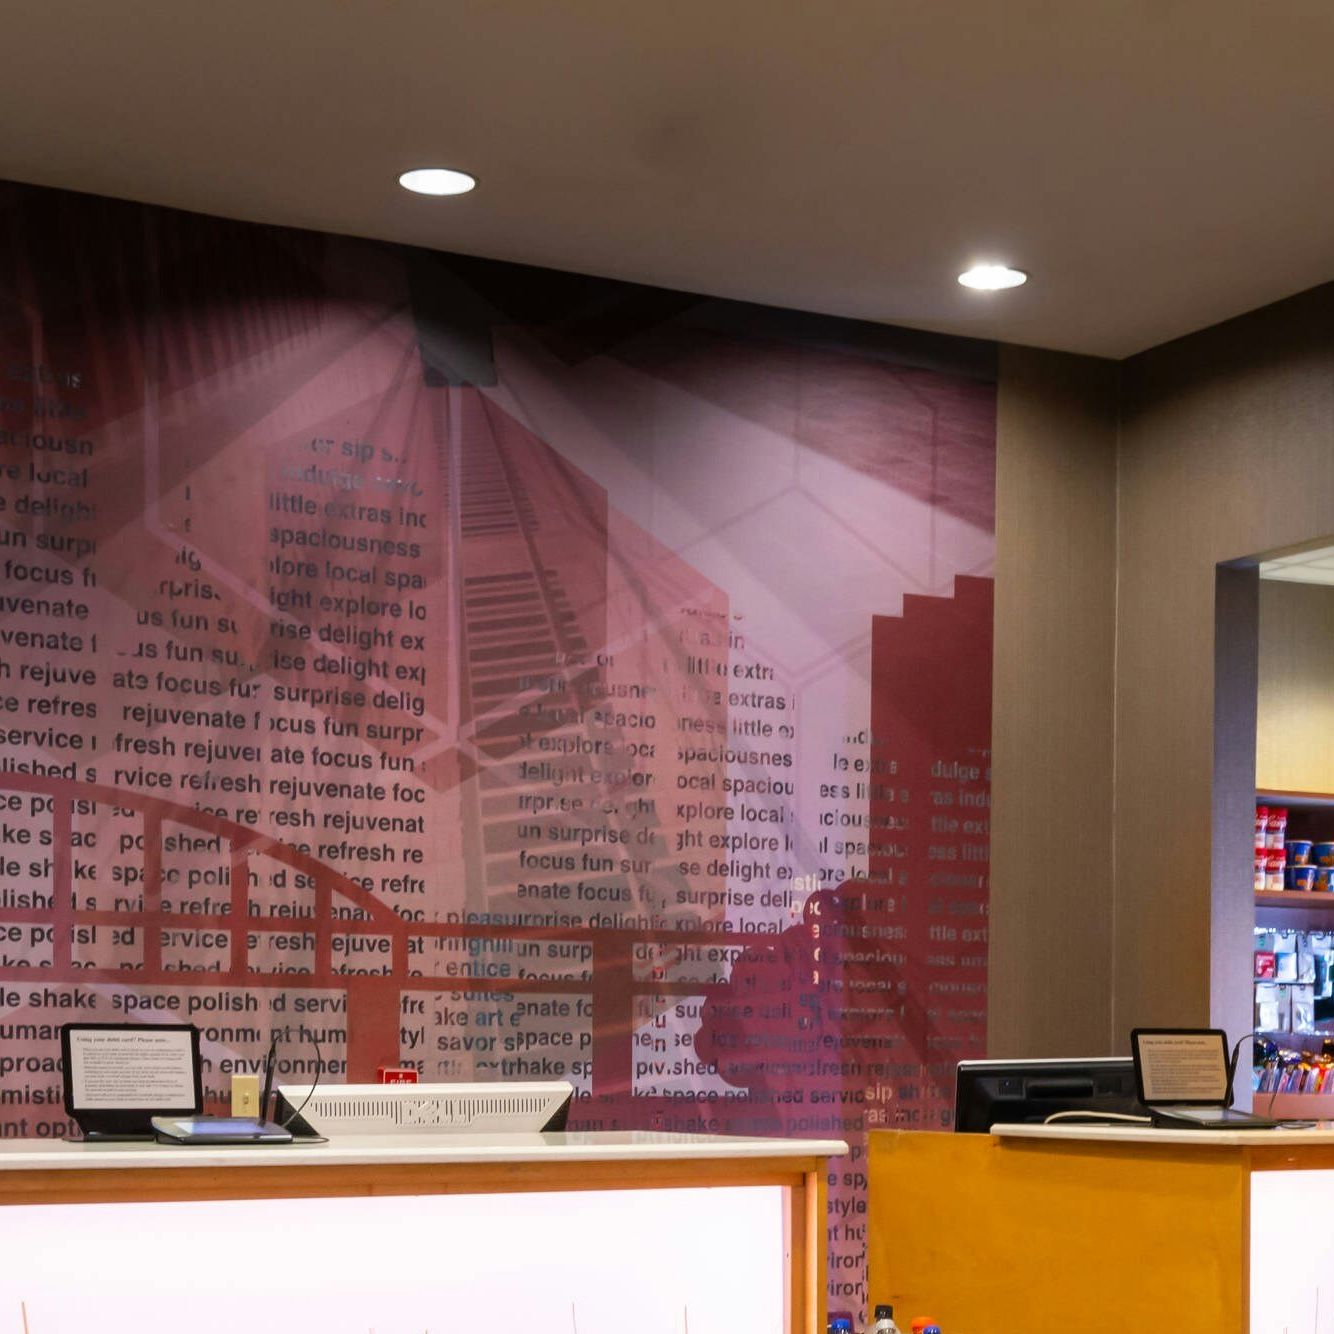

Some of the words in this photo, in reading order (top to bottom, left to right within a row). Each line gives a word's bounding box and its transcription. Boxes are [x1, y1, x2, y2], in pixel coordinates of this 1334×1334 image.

[324, 499, 392, 524] extras
[270, 527, 421, 558] spaciousness
[4, 560, 74, 587] focus
[325, 561, 377, 586] local
[319, 593, 402, 620] explore
[171, 610, 209, 631] fun
[319, 624, 394, 653] delight
[167, 642, 203, 663] fun
[20, 663, 96, 688] rejuve
[313, 654, 389, 682] delight
[156, 671, 221, 696] focus
[27, 697, 96, 720] refres
[273, 683, 365, 710] surprise
[372, 689, 425, 717] delig
[729, 690, 786, 711] extras
[123, 704, 246, 731] rejuvenate
[733, 717, 773, 738] little
[324, 715, 359, 738] fun
[366, 721, 424, 747] surpr
[115, 733, 175, 757] fresh
[312, 746, 373, 770] focus
[380, 751, 415, 773] fun
[269, 775, 385, 802] rejuvenate
[393, 782, 425, 803] foc
[323, 811, 425, 836] rejuvenat
[741, 804, 785, 823] local
[548, 824, 630, 849] surprise
[709, 831, 779, 855] explore
[318, 838, 395, 862] refresh
[403, 845, 424, 864] re
[519, 850, 576, 872] focus
[582, 851, 614, 873] fun
[707, 859, 771, 883] delight
[578, 881, 631, 901] focus
[676, 889, 753, 910] surprise
[739, 916, 783, 934] local
[446, 958, 511, 977] entice
[113, 991, 180, 1016] space
[475, 1006, 504, 1027] art
[437, 1034, 496, 1052] savor
